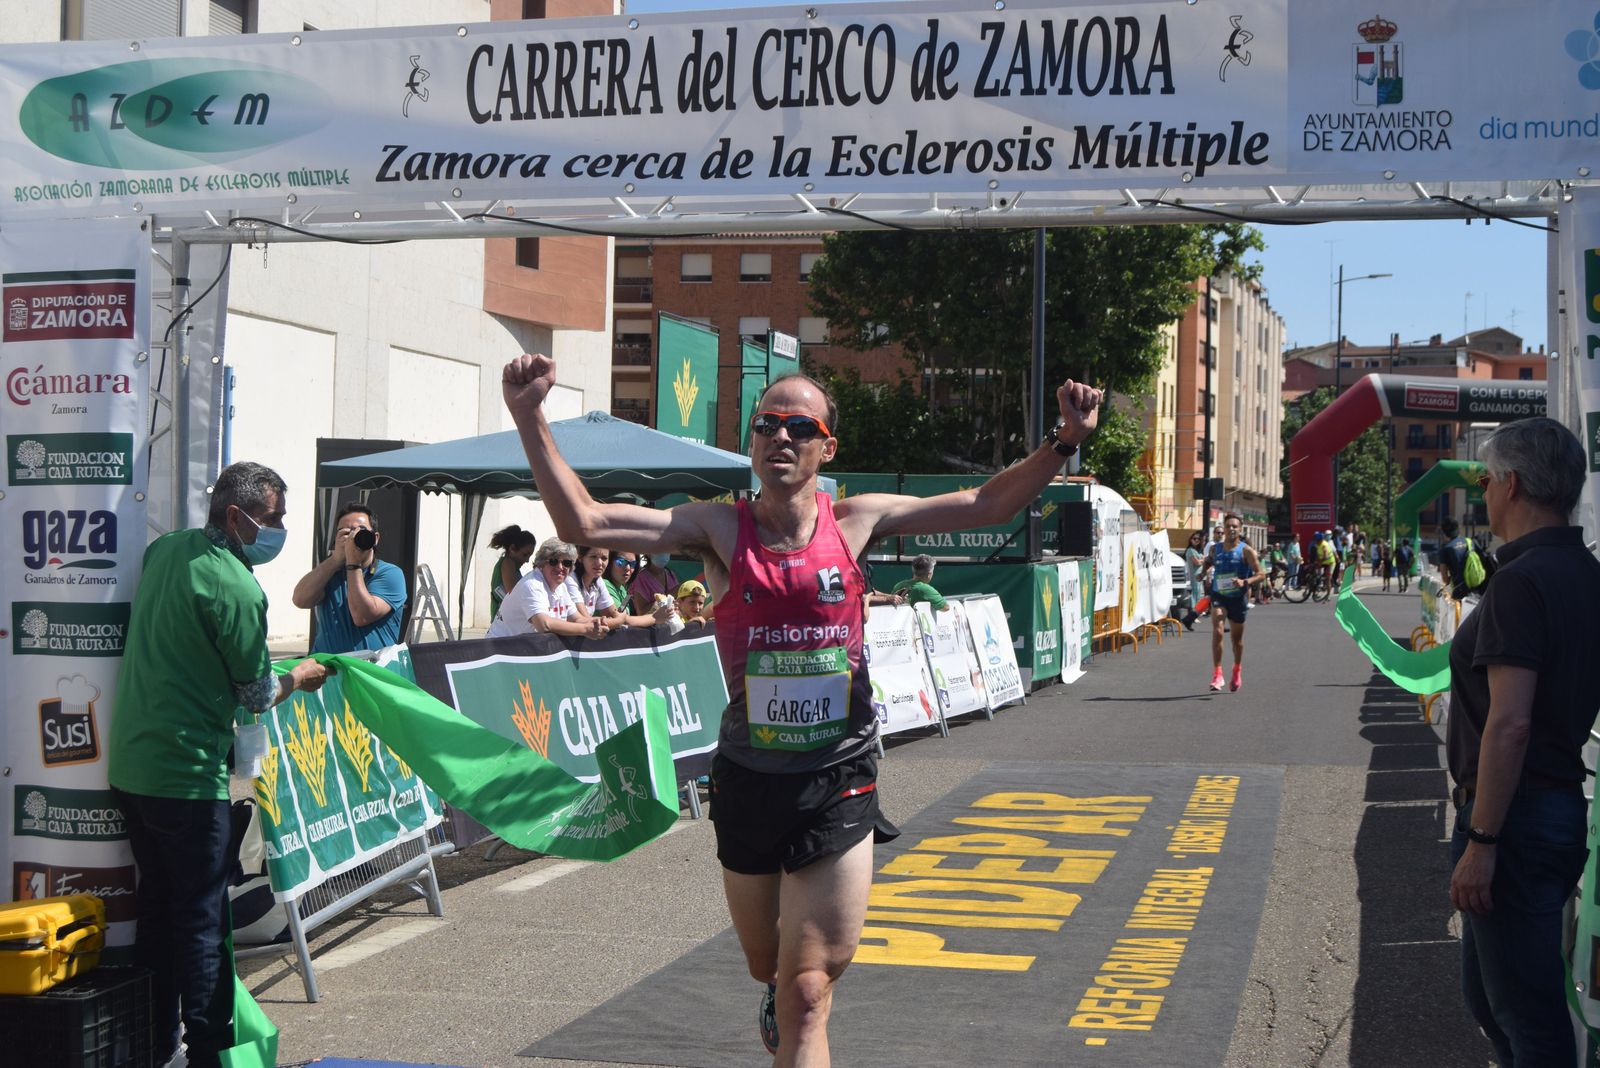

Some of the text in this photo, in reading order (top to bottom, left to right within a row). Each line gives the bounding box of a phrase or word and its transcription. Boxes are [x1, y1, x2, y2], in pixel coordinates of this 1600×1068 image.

[466, 14, 1176, 125] CARRERA del CERCO de ZAMORA
[1303, 109, 1453, 130] AYUNTAMIENTO
[1479, 117, 1518, 140] dia
[1303, 129, 1452, 152] DE ZAMORA
[376, 121, 1270, 182] Zamora cerca de la Esclerosis Múltiple
[14, 167, 350, 202] ASOCIACIÓN ZAMORANA DE ESCLEROSIS MÚLTIPLE
[32, 293, 127, 308] DIPUTACIÓN DE
[31, 308, 128, 329] ZAMORA
[1469, 387, 1497, 398] CON
[1501, 388, 1515, 399] EL
[51, 404, 88, 415] Zamora
[1417, 398, 1456, 407] ZAMORA
[1469, 402, 1531, 414] GANAMOS
[47, 452, 125, 465] FUNDACION
[48, 466, 125, 479] CAJA RURAL
[22, 510, 118, 570] gaza
[914, 533, 1017, 547] CAJA RURAL
[24, 573, 118, 585] Ganaderos de Zamora
[49, 623, 124, 637] FUNDACION
[747, 623, 850, 648] Fisiorama
[49, 637, 124, 650] CAJA RURAL
[776, 652, 837, 665] FUNDACION
[777, 662, 839, 674] CAJA RURAL
[773, 684, 778, 697] 1
[766, 697, 831, 724] GARGAR
[558, 682, 703, 757] CAJA RAL
[44, 715, 92, 750] Susi
[778, 726, 842, 744] CAJA RURAL
[47, 822, 127, 836] CAJA RURAL
[1124, 866, 1215, 932] INTEGRAL
[1067, 937, 1190, 1032] REFORMA
